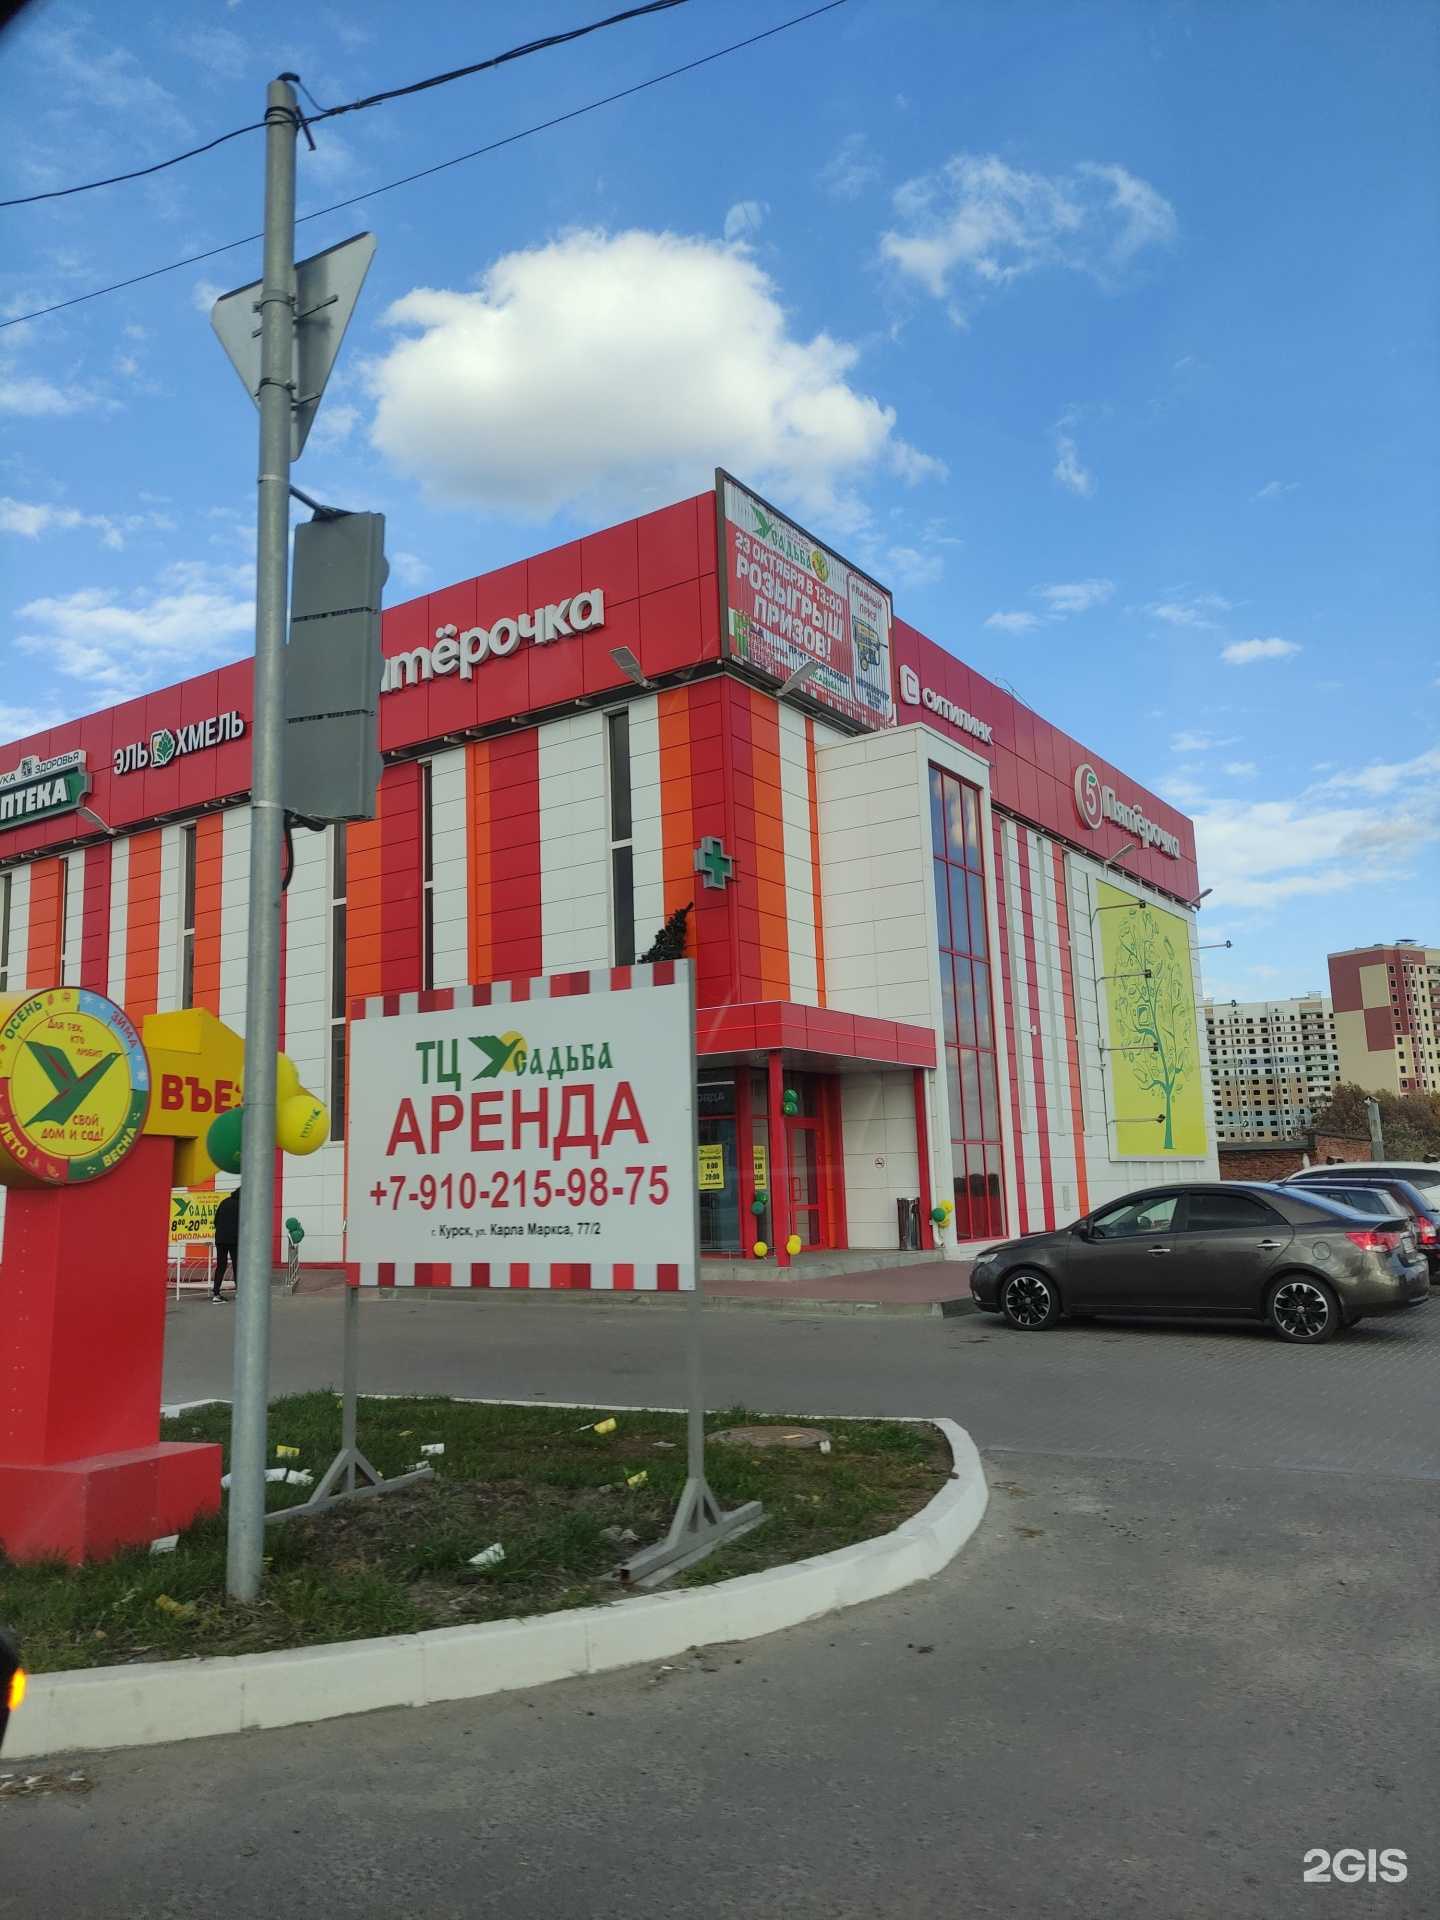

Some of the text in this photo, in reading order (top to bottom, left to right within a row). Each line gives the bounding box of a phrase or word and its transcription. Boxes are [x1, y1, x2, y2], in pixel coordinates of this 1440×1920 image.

[735, 532, 750, 554] 23
[753, 543, 805, 592] ОКТЯБРЯ
[807, 580, 814, 595] В
[736, 553, 843, 641] РОЗЫГРЫШ
[754, 593, 831, 662] ПРИЗОВ!
[34, 751, 80, 774] ЗДОРОВЬЯ
[113, 710, 244, 775] ЭЛЬ ХМЕЛЬ
[1101, 785, 1181, 860] Пятёрочка
[4, 1000, 43, 1040] ОСЕНЬ
[110, 1010, 138, 1049] ЗИМА
[415, 1038, 462, 1091] ТЦ
[0, 1121, 28, 1159] ЛЕТО
[385, 1080, 649, 1161] АРЕНДА
[102, 1127, 137, 1167] ВЕСНА
[369, 1164, 670, 1211] +7-910-215-98-75
[438, 1223, 474, 1240] Курск,
[490, 1223, 525, 1239] Карла
[527, 1222, 574, 1239] Маркса,
[576, 1222, 602, 1236] 77/2
